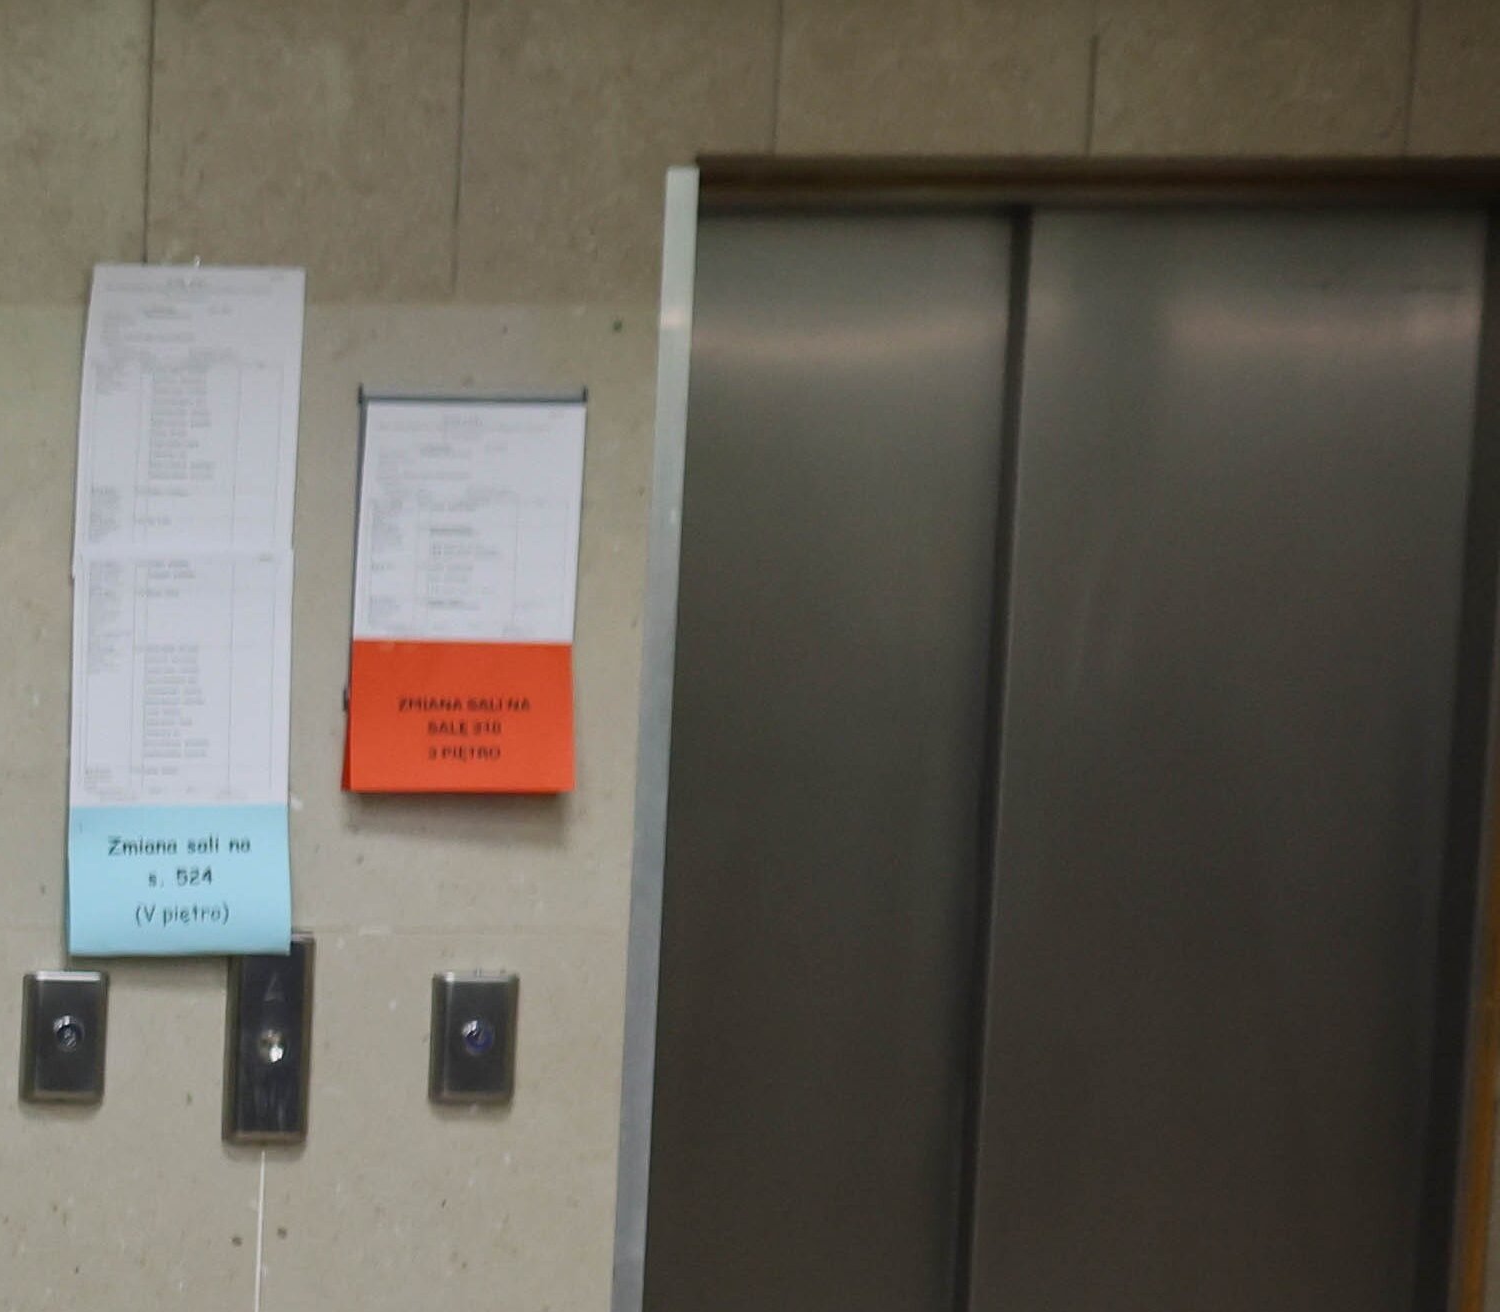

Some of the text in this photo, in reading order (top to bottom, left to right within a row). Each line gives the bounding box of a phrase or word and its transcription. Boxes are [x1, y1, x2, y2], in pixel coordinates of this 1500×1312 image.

[107, 834, 251, 856] Zmiana sali na
[175, 866, 213, 887] 524
[135, 902, 157, 926] (V
